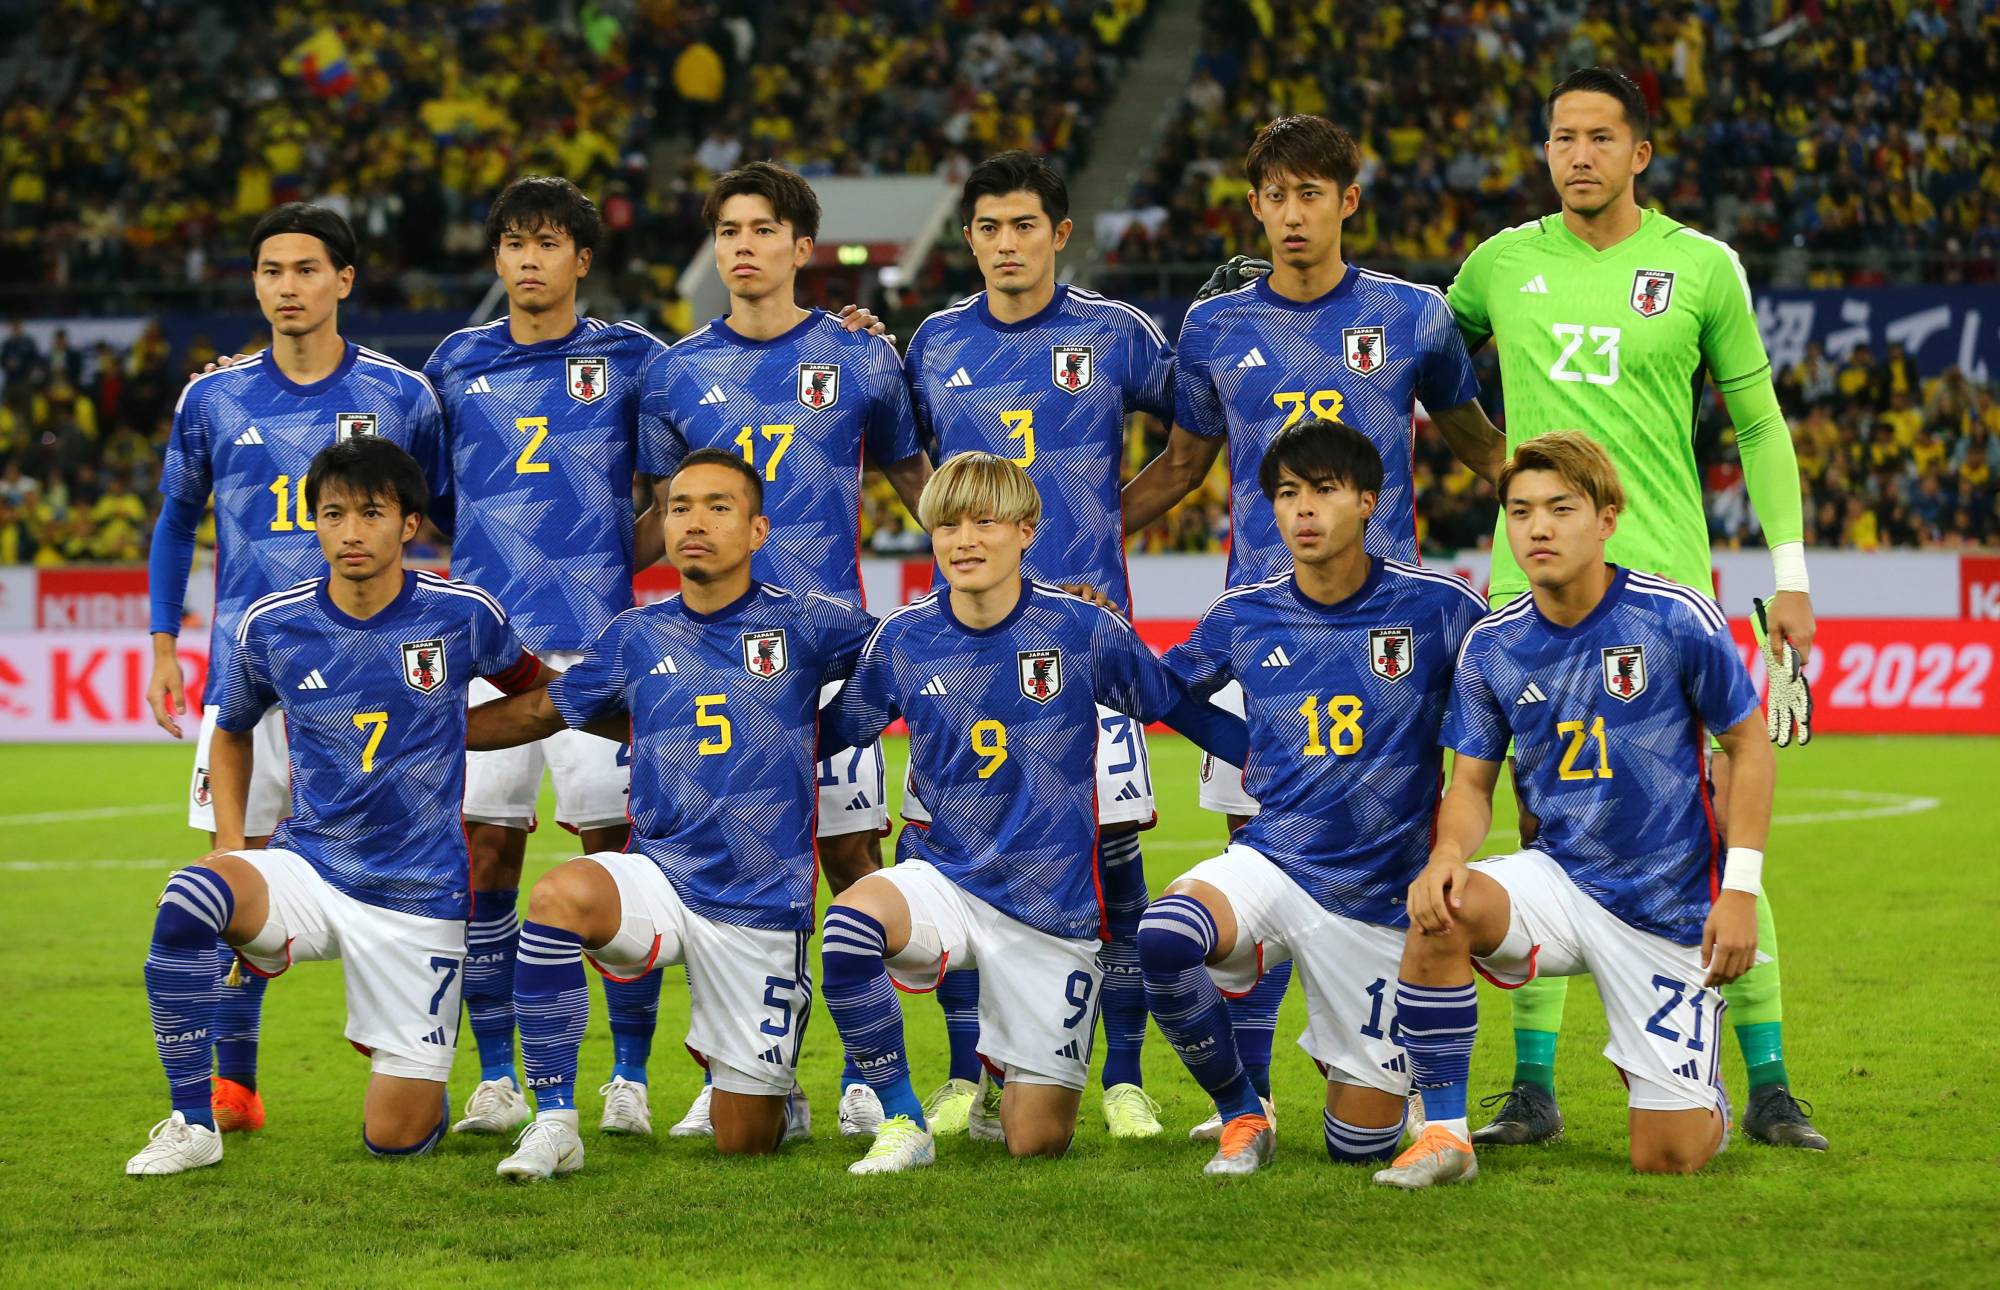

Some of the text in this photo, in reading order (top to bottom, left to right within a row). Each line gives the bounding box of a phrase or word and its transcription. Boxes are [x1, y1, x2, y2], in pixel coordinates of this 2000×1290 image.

[1064, 377, 1081, 385] JFA
[1357, 360, 1374, 368] JFA
[1550, 324, 1621, 387] 23
[809, 396, 826, 404] JFA
[515, 416, 550, 473] 2
[735, 424, 795, 481] 17
[1000, 409, 1035, 467] 3
[45, 594, 150, 630] KIRI
[52, 647, 209, 724] KIR
[418, 676, 435, 685] JFA
[759, 664, 776, 672] JFA
[1034, 686, 1051, 694] JFA
[1383, 664, 1401, 672] JFA
[1617, 684, 1635, 692] JFA
[1830, 643, 1993, 708] 2022
[353, 712, 388, 772] 7
[695, 694, 731, 755] 5
[971, 719, 1008, 779] 9
[1100, 719, 1137, 775] 3
[1298, 695, 1363, 755] 18
[1557, 716, 1613, 780] 21
[429, 956, 460, 1016] 7
[465, 952, 504, 964] PAN
[1105, 964, 1142, 974] JAP
[760, 975, 796, 1037] 5
[1063, 969, 1093, 1029] 9
[1360, 978, 1402, 1047] 1
[1646, 974, 1707, 1052] 21
[157, 1028, 207, 1044] APAN
[855, 1051, 898, 1069] APAN
[527, 1074, 562, 1088] PAN
